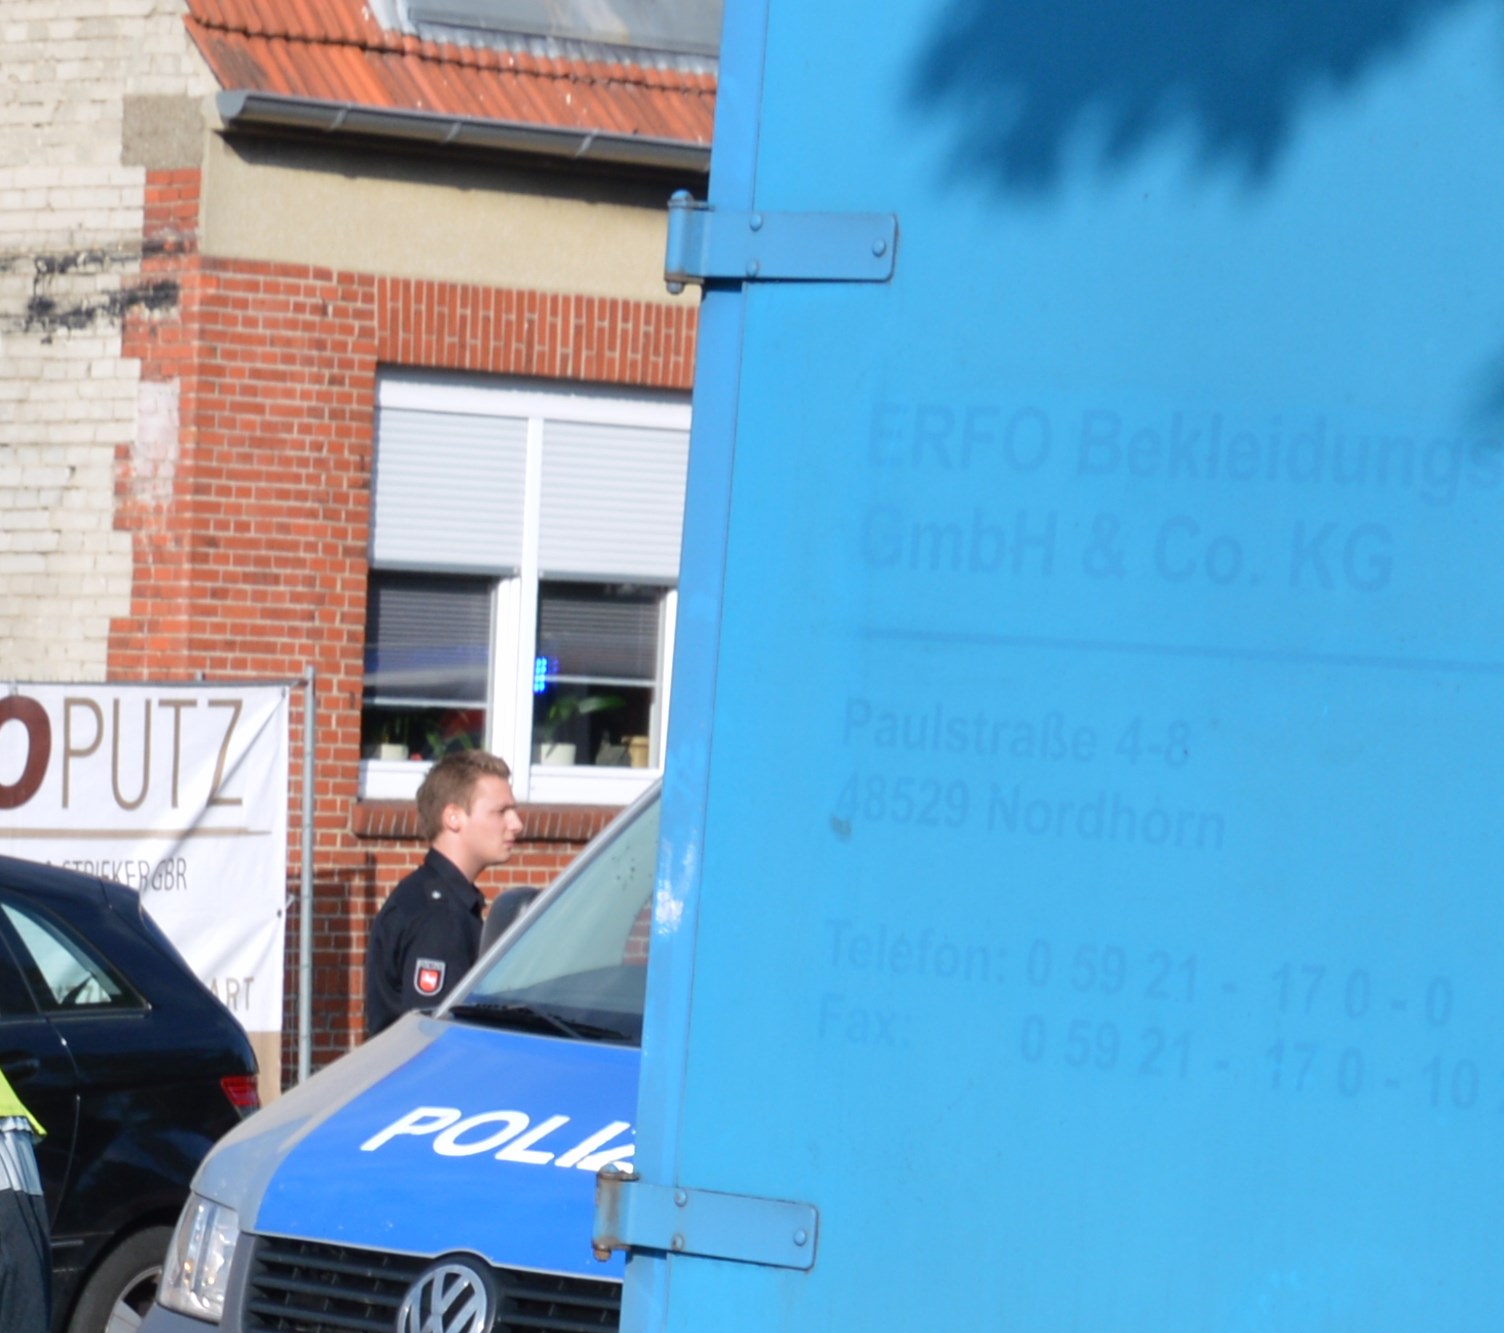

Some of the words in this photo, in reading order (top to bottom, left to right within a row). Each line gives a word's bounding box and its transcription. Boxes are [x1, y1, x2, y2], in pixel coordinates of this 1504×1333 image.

[865, 400, 1052, 476] ERFO
[860, 503, 1058, 580] GmbH
[1080, 511, 1128, 580] &
[1152, 514, 1264, 590] Co.
[1288, 520, 1396, 593] KG
[842, 696, 1098, 763] Paulstraße
[1115, 716, 1194, 770] 4-8
[834, 769, 971, 830] 48529
[985, 782, 1228, 850] Nordhorn
[823, 916, 1009, 985] Telefon:
[816, 990, 915, 1048] Fax:
